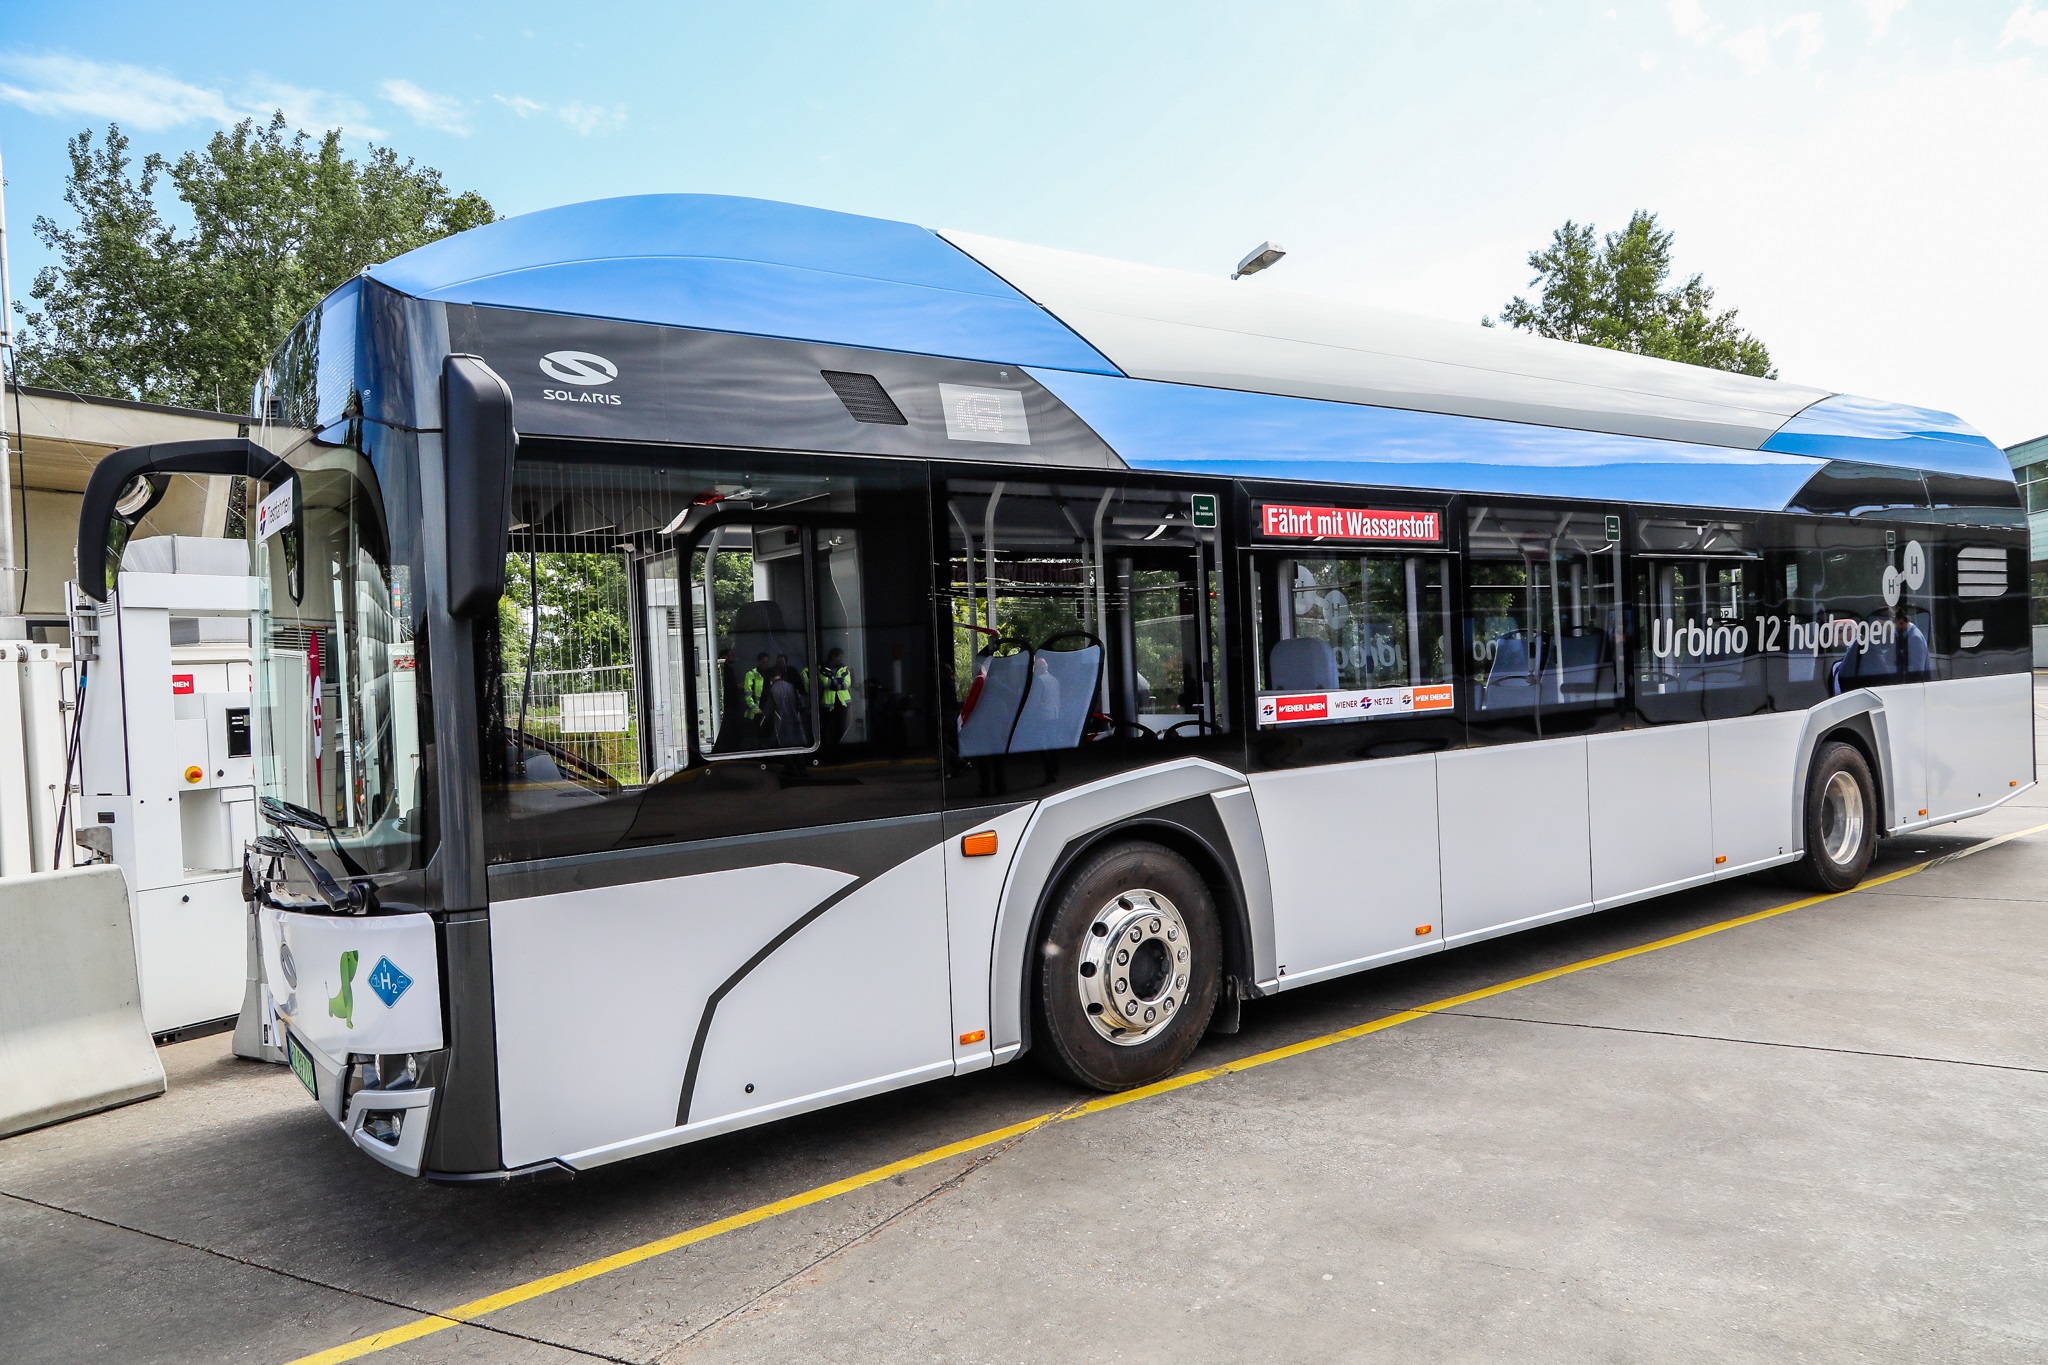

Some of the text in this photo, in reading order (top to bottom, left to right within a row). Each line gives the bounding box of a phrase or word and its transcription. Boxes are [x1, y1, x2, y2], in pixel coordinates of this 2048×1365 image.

[543, 389, 621, 405] SOLARIS
[1267, 507, 1434, 538] Fährt mit Wasserstoff
[1652, 613, 1895, 658] Urbino 12 hydrogen
[1334, 697, 1393, 709] WIENER NETZE
[1415, 692, 1451, 702] WIEN ENERGIE
[1278, 702, 1325, 713] WIENER LINIEN
